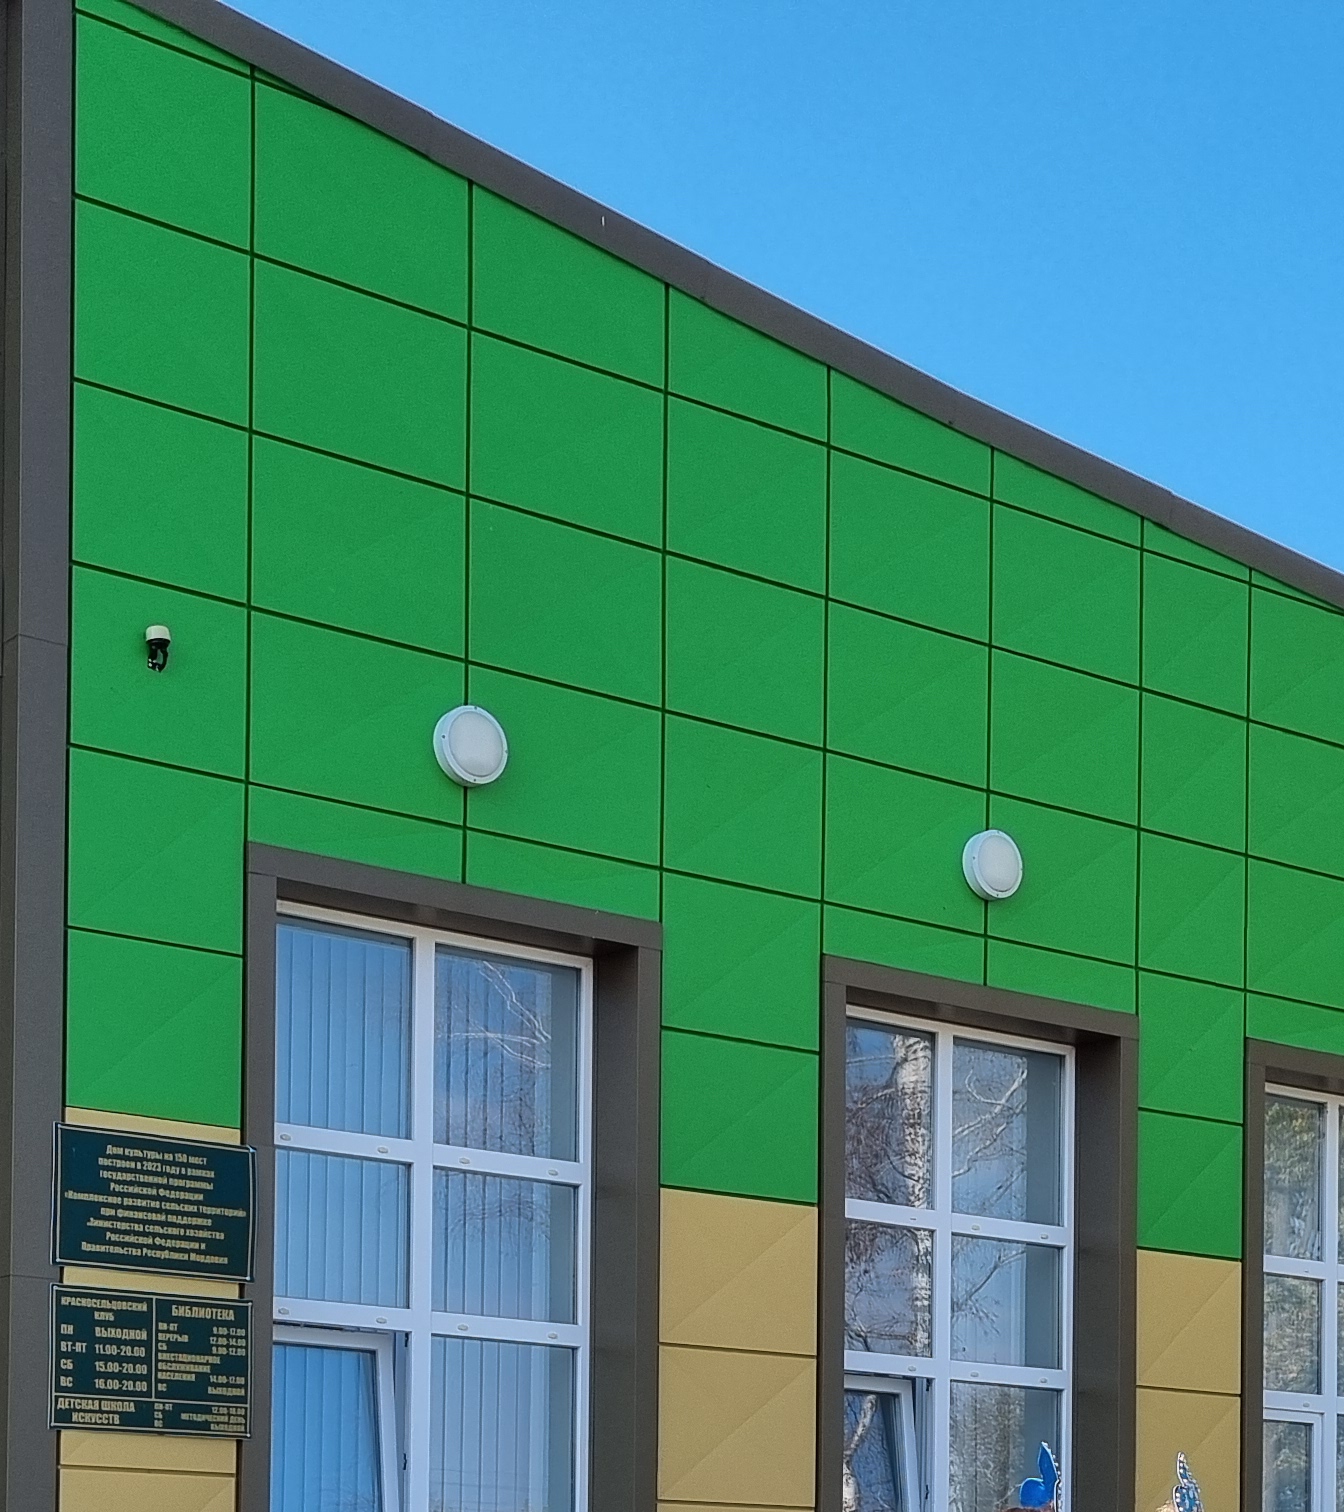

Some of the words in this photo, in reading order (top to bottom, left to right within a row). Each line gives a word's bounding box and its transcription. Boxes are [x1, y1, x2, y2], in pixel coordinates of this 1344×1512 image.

[106, 1144, 123, 1155] Дом
[124, 1149, 162, 1160] культуры
[175, 1153, 187, 1163] 150
[142, 1161, 161, 1172] 2023
[94, 1311, 115, 1321] КЛУБ
[171, 1304, 235, 1321] БИБЛИОТЕКА
[60, 1323, 74, 1335] ПН
[94, 1326, 148, 1341] ВЫХОДНОЙ
[60, 1340, 88, 1354] ВТ-ПТ
[94, 1344, 146, 1358] 11.00-20.00
[60, 1358, 74, 1370] СБ
[94, 1361, 148, 1375] 15.00-20.00
[59, 1375, 74, 1388] ВС
[94, 1378, 148, 1392] 16.00-20.00
[57, 1397, 100, 1411] ДЕТСКАЯ
[100, 1400, 136, 1413] ШКОЛА
[72, 1411, 120, 1425] ИСКУССТВ
